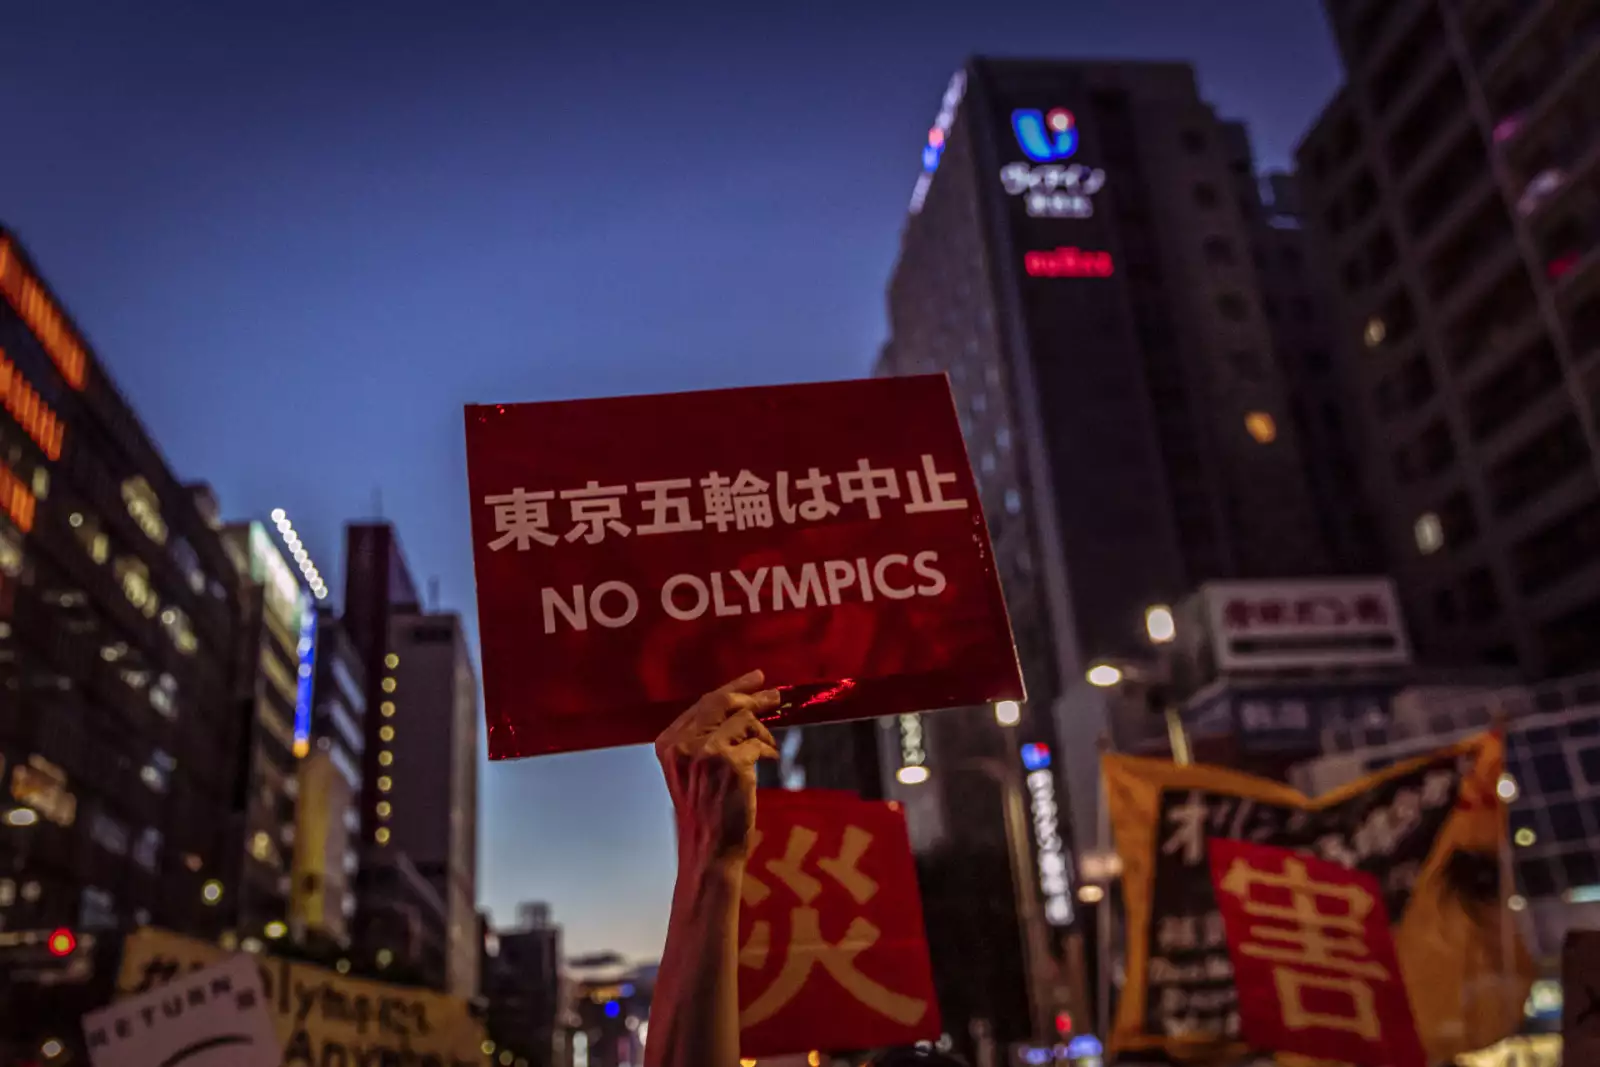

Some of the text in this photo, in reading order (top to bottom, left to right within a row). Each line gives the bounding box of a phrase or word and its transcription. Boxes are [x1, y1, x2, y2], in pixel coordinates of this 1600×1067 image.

[484, 454, 968, 551] 東京五輪は中止
[541, 550, 947, 635] NO OLYMPICS
[738, 824, 928, 1027] 災
[1219, 855, 1392, 1041] 害
